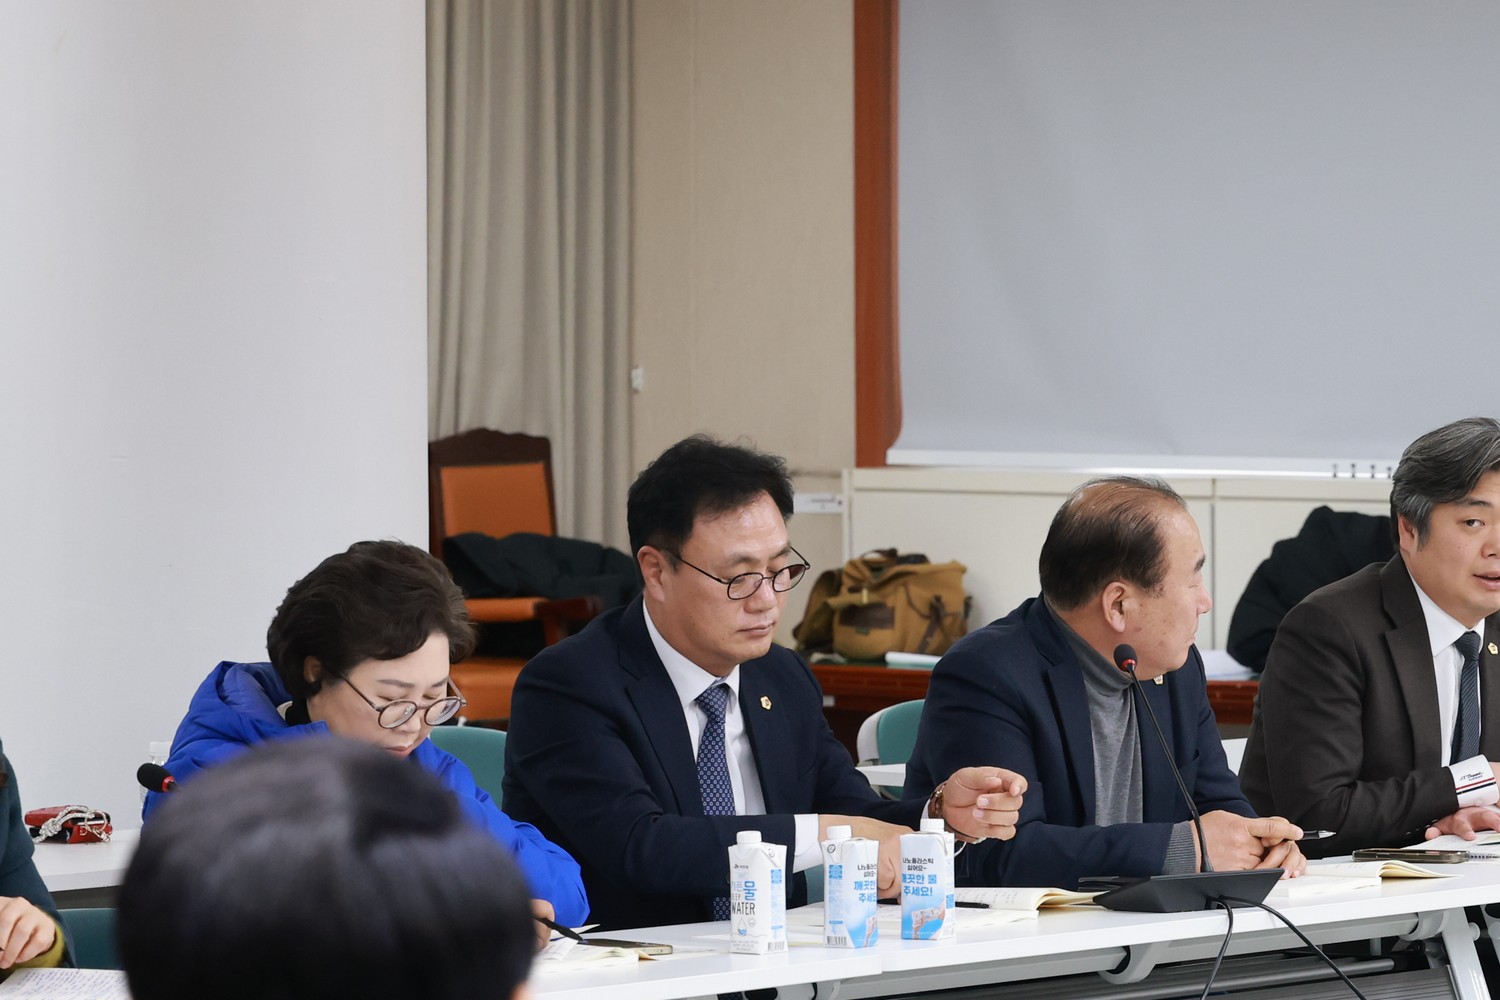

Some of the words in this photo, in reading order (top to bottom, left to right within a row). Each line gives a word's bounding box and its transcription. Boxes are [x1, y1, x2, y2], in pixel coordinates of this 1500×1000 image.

[743, 880, 757, 901] 물
[904, 886, 933, 897] 주세요!
[731, 902, 756, 915] WATER
